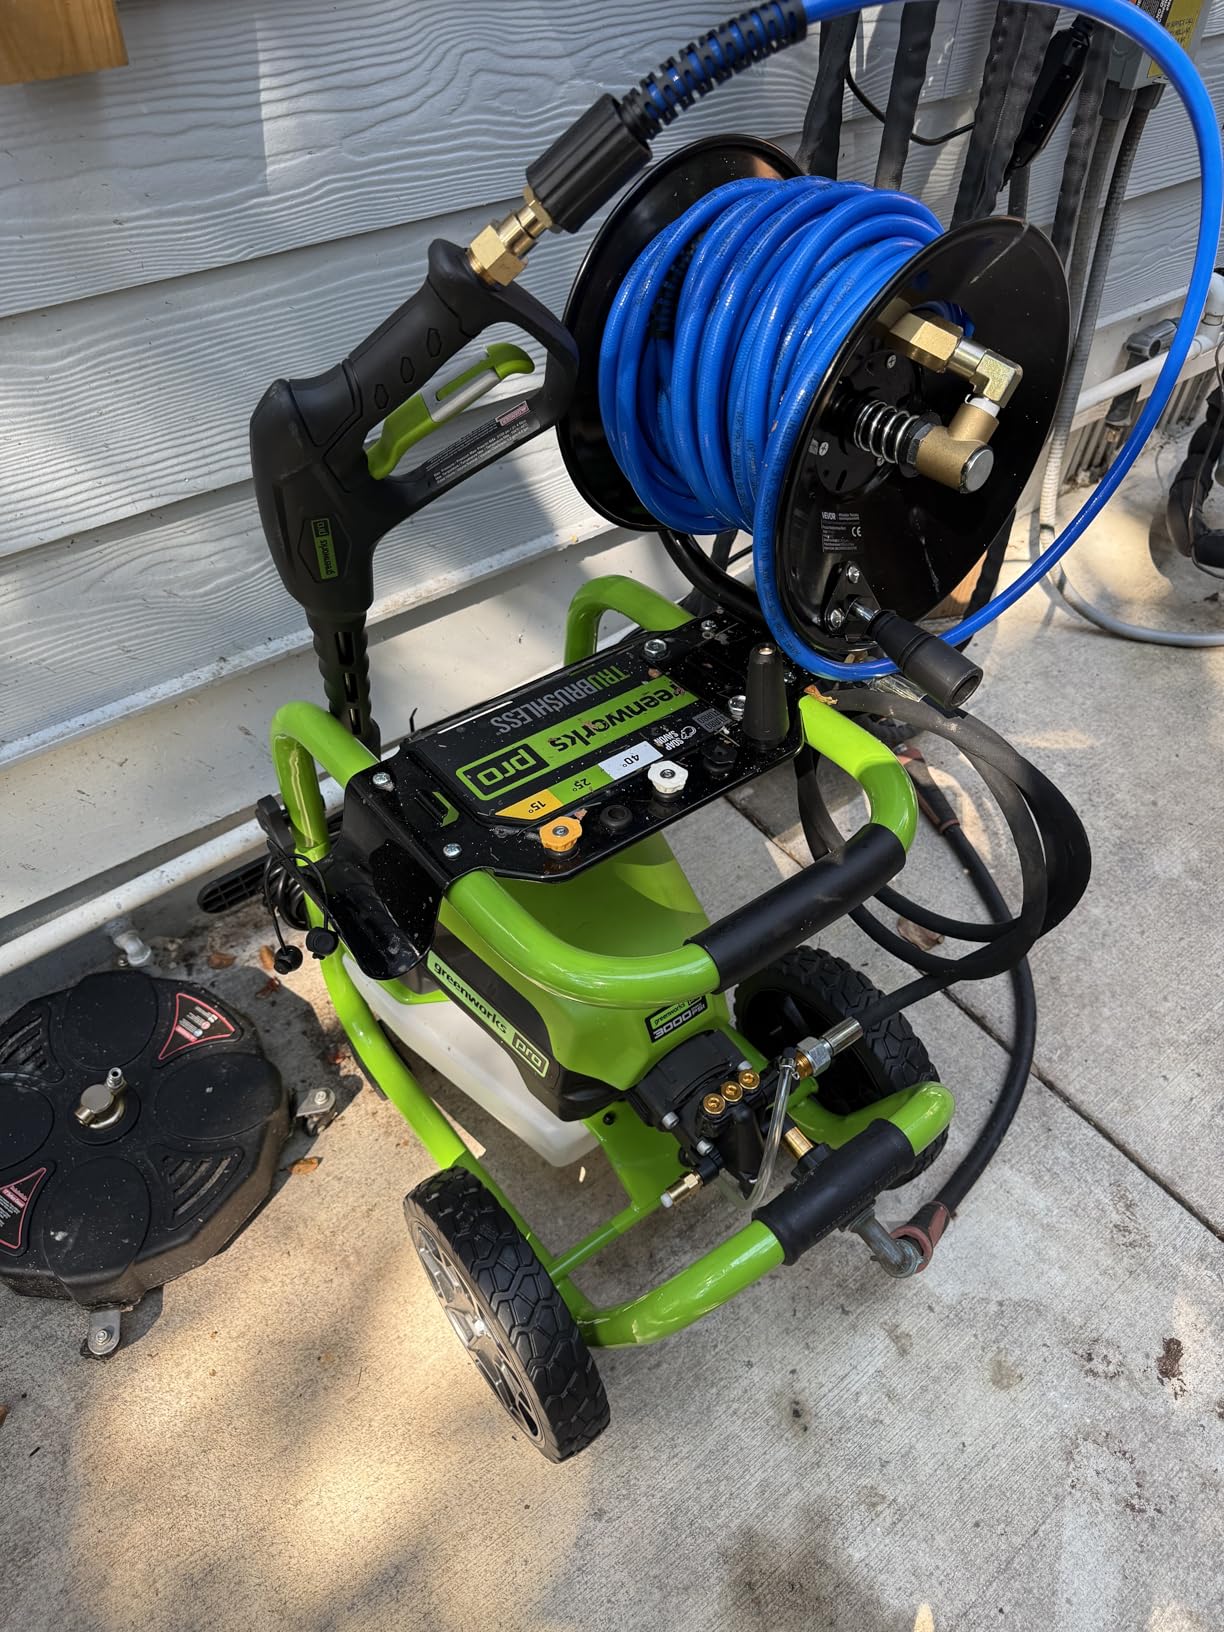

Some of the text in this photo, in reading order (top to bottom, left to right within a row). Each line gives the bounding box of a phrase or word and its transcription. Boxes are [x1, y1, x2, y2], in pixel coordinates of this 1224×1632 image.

[822, 512, 836, 520] VEVOR
[654, 730, 679, 745] SAVON
[665, 738, 684, 751] SOAP
[477, 749, 537, 786] pro
[434, 962, 542, 1068] greenworks pro
